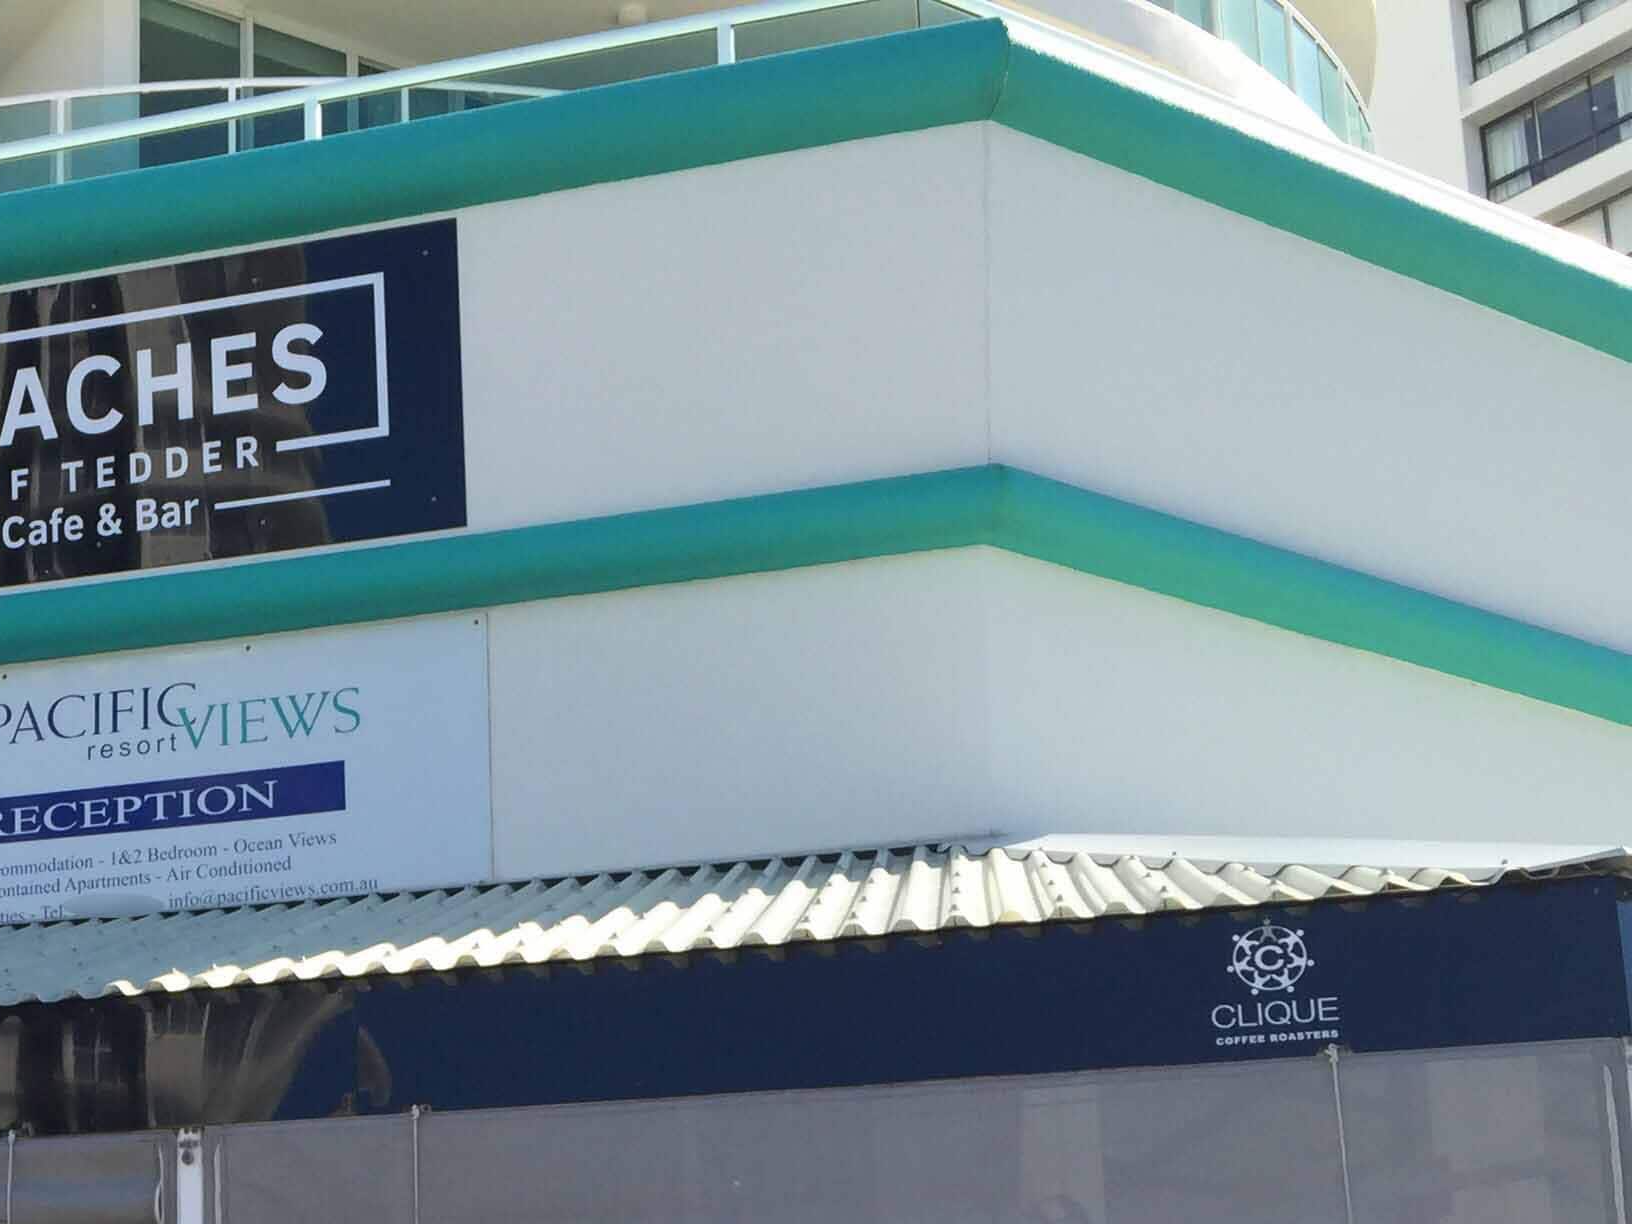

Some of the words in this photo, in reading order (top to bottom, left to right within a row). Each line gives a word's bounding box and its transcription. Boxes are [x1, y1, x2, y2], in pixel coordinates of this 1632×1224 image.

[61, 436, 260, 493] TEDDER
[2, 508, 84, 550] Cafe
[96, 503, 123, 536] &
[136, 496, 199, 532] Bar
[177, 687, 361, 749] VIEWS
[87, 733, 177, 761] resort
[111, 849, 143, 866] 1&2
[147, 844, 217, 862] Bedroom
[233, 835, 284, 854] Ocean
[288, 831, 337, 848] Views
[65, 873, 151, 895] Apartments
[167, 867, 192, 882] Air
[196, 856, 292, 879] Conditioned
[168, 878, 378, 909] info@pacificviews.com.au
[1211, 997, 1341, 1029] CLIQUE
[1216, 1033, 1266, 1046] COFFEE
[1270, 1029, 1339, 1042] ROASTERS
